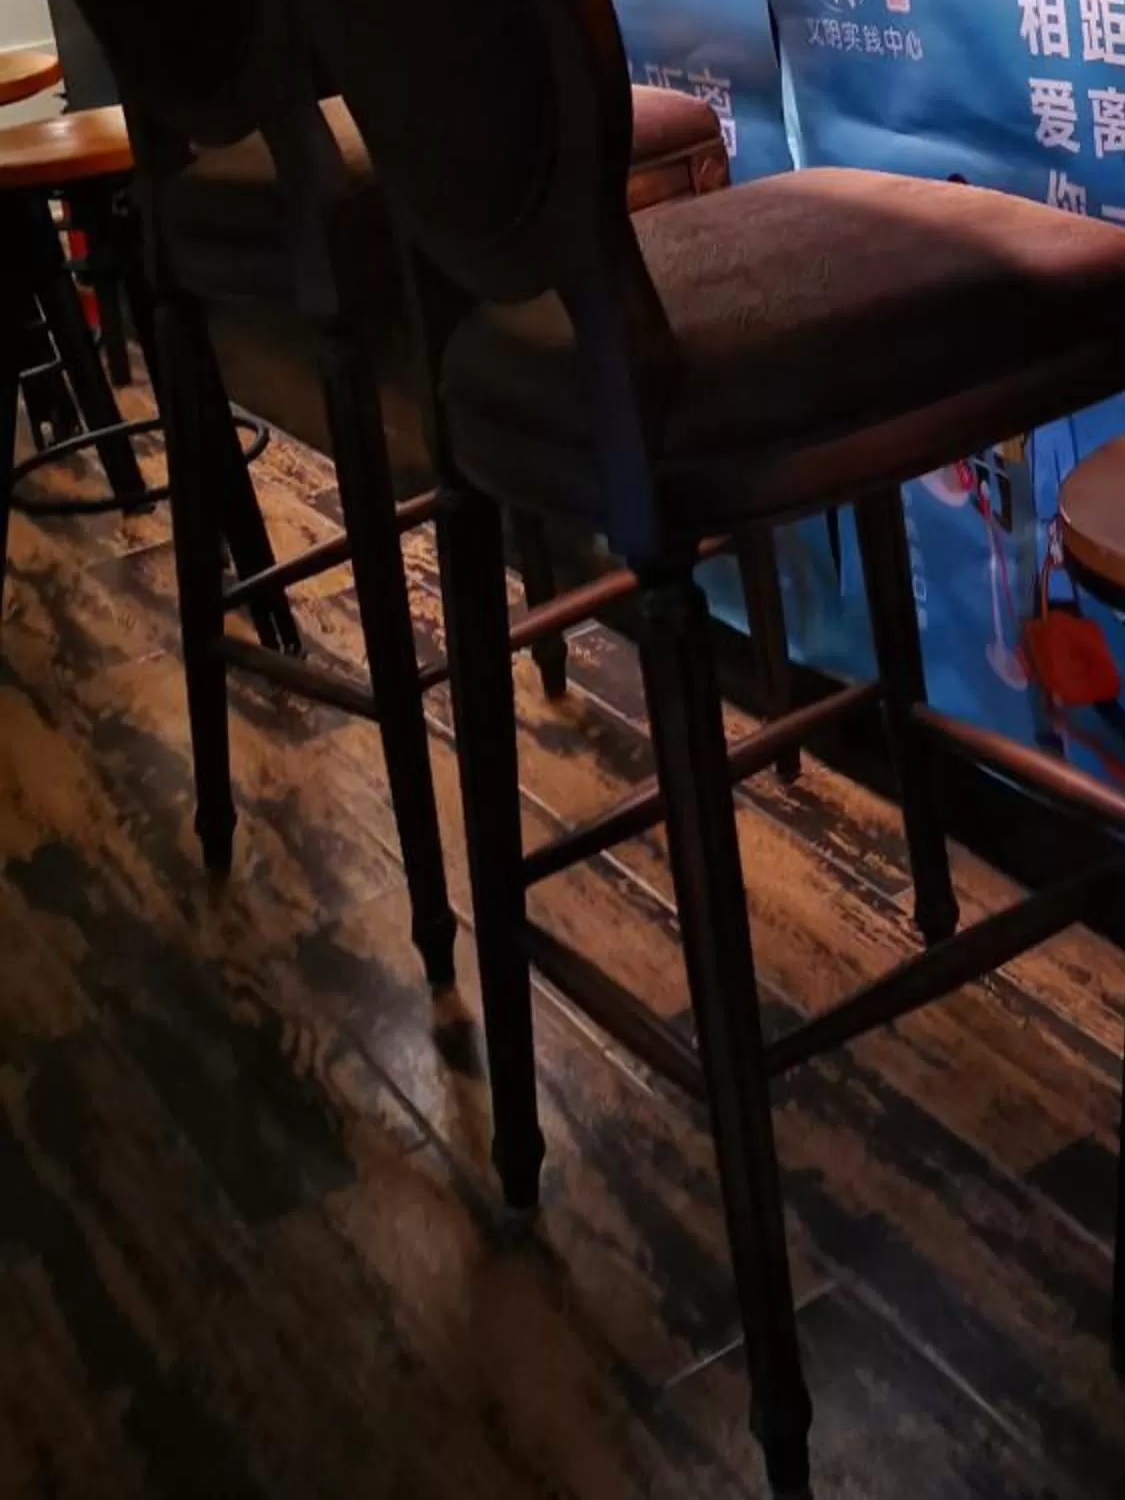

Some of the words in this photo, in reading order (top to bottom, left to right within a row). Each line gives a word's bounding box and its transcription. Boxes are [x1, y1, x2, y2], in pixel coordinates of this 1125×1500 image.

[806, 16, 924, 62] 文明实践中心
